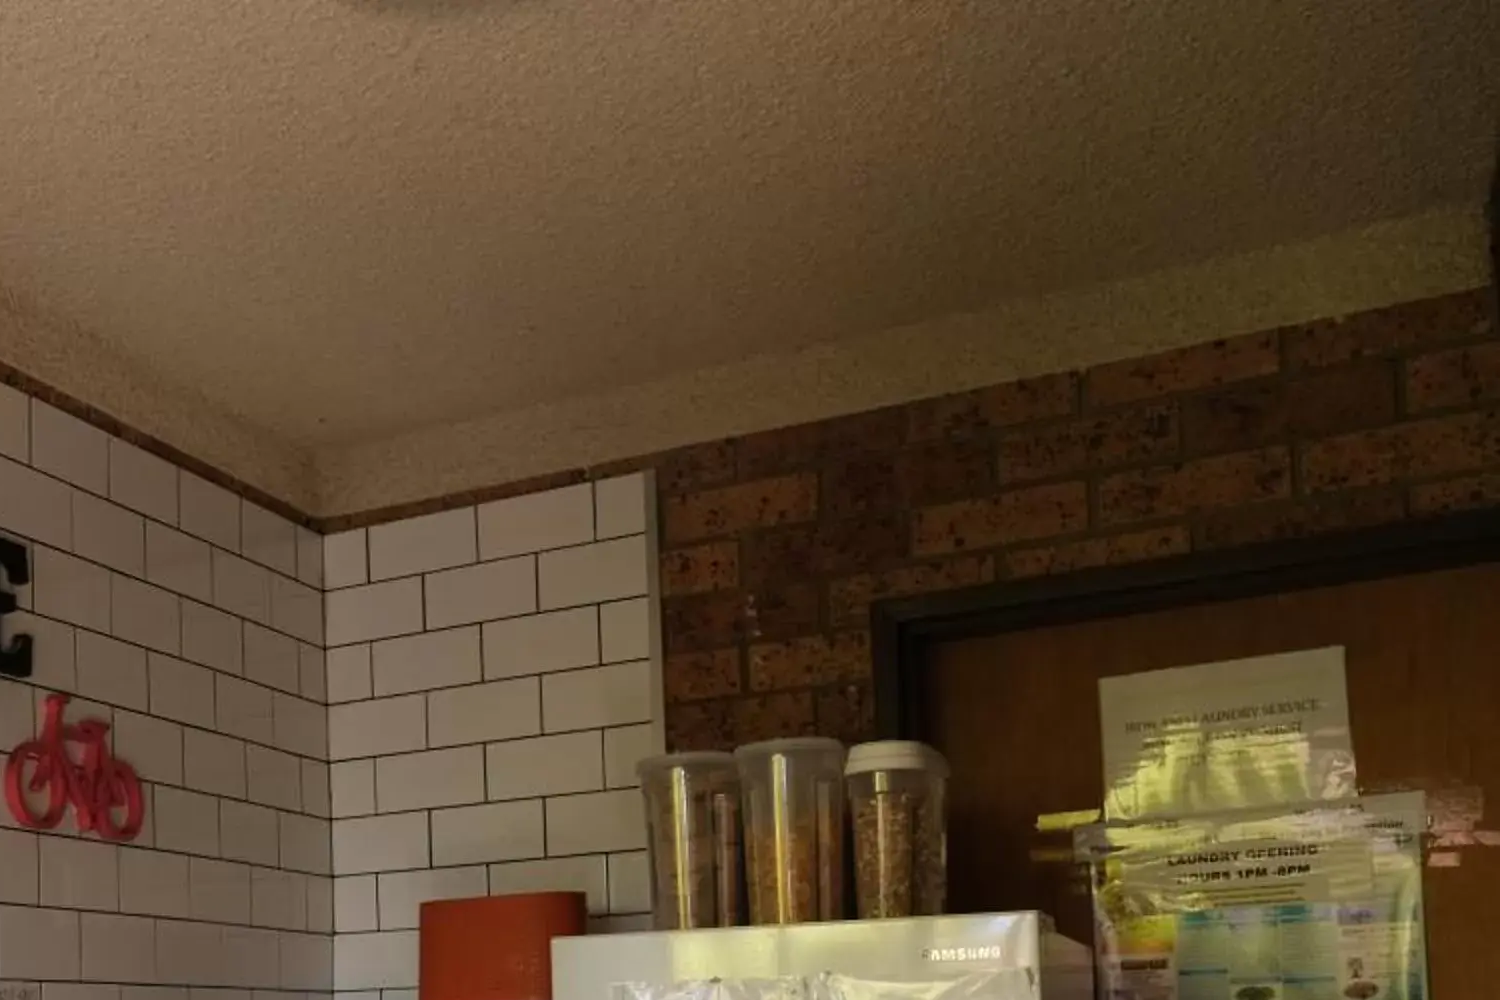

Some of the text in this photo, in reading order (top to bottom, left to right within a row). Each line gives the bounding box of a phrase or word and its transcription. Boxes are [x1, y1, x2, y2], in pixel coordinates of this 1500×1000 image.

[1167, 844, 1319, 867] LAUNDRY OPENING
[920, 945, 1002, 962] SAMSUNG
